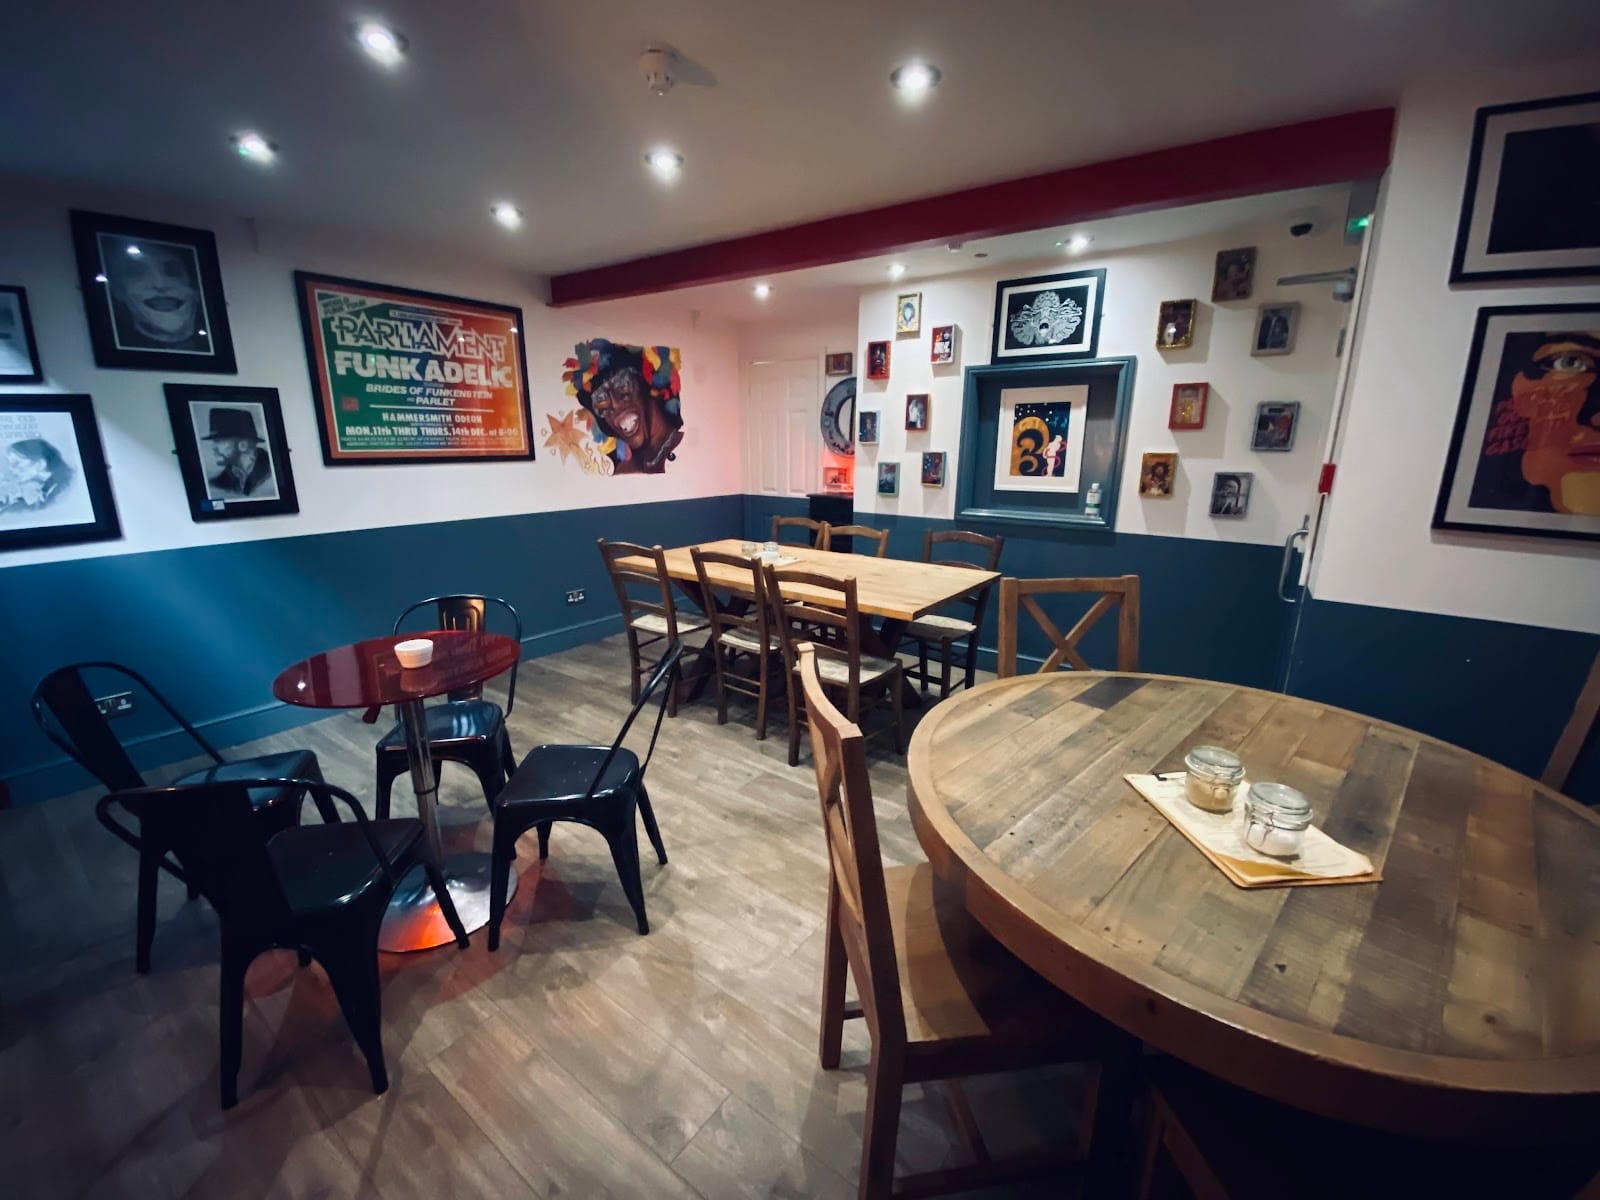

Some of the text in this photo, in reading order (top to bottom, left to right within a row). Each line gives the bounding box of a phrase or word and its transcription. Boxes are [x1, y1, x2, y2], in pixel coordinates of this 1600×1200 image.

[331, 311, 507, 365] PARLIAMENT
[334, 350, 514, 388] FUNKADELIC
[366, 384, 493, 399] BRIDES OF FUNKENSTEIN
[416, 396, 456, 406] PARLET
[382, 412, 483, 424] HAMMERSMITH ODEON
[392, 427, 418, 436] THRU
